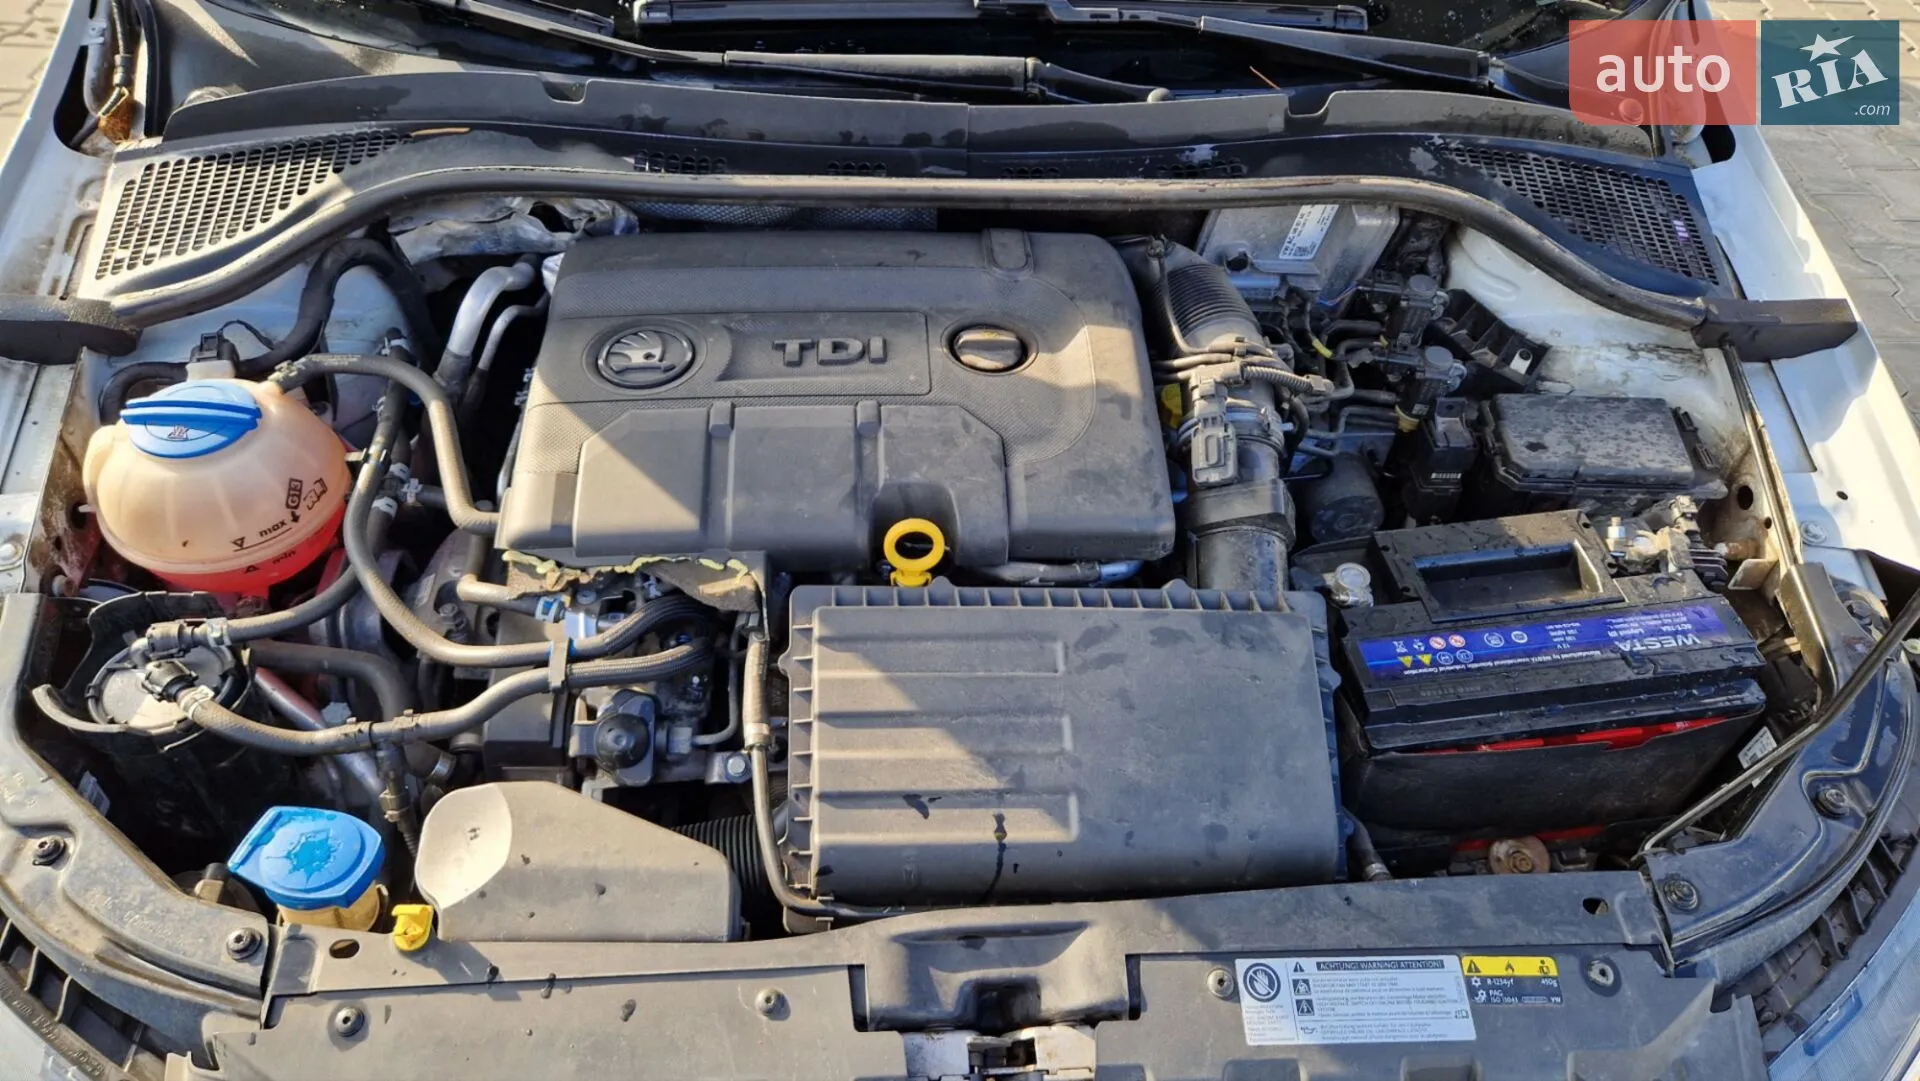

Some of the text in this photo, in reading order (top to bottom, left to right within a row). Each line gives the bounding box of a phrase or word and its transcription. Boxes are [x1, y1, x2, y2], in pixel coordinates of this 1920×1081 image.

[773, 337, 887, 366] TDI
[259, 519, 287, 537] max
[1614, 633, 1701, 652] WESTA
